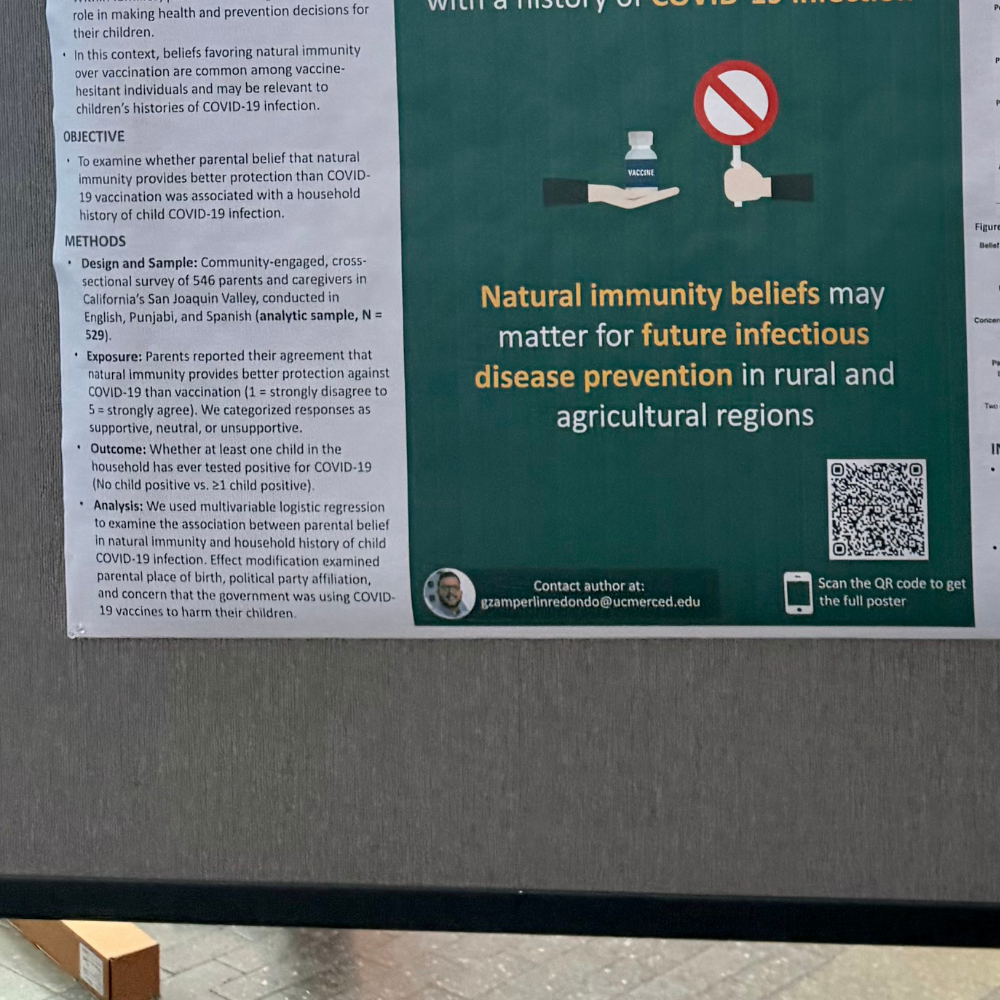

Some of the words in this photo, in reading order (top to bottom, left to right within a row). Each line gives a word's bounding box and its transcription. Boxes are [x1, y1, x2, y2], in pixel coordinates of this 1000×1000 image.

[63, 130, 125, 143] OBJECTIVE
[78, 155, 90, 167] To
[92, 155, 142, 167] examine
[145, 153, 196, 166] whether
[199, 152, 249, 168] parental
[252, 151, 286, 165] belief
[289, 152, 314, 164] that
[317, 150, 360, 164] natural
[627, 169, 654, 177] VACCINE
[65, 234, 126, 248] METHODS
[81, 257, 119, 272] Design
[122, 256, 145, 269] and
[148, 256, 198, 271] Sample:
[200, 254, 329, 270] Community-engaged,
[332, 257, 367, 267] cross-
[481, 282, 582, 309] Natural
[590, 281, 723, 312] immunity
[730, 280, 821, 306] beliefs
[829, 286, 885, 310] may
[499, 325, 589, 348] matter
[595, 322, 635, 347] for
[641, 321, 727, 347] future
[735, 320, 870, 346] infectious
[474, 363, 575, 389] disease
[584, 362, 733, 394] prevention
[742, 362, 765, 386] in
[775, 360, 836, 386] rural
[845, 360, 894, 386] and
[557, 401, 707, 434] agricultural
[717, 402, 814, 433] regions
[93, 499, 143, 514] Analysis:
[146, 500, 166, 512] We
[169, 499, 197, 512] used
[200, 500, 276, 513] multivariable
[279, 500, 321, 515] logistic
[323, 501, 385, 516] regression
[533, 580, 581, 592] Contact
[584, 579, 626, 592] author
[628, 581, 645, 592] at:
[818, 577, 848, 590] Scan
[850, 576, 872, 589] the
[874, 577, 894, 591] QR
[896, 577, 927, 590] code
[929, 578, 944, 590] to
[946, 578, 966, 592] get
[480, 595, 701, 610] gzamperlinredondo@ucmerced.edu
[819, 594, 841, 607] the
[843, 594, 863, 607] full
[866, 596, 907, 609] poster
